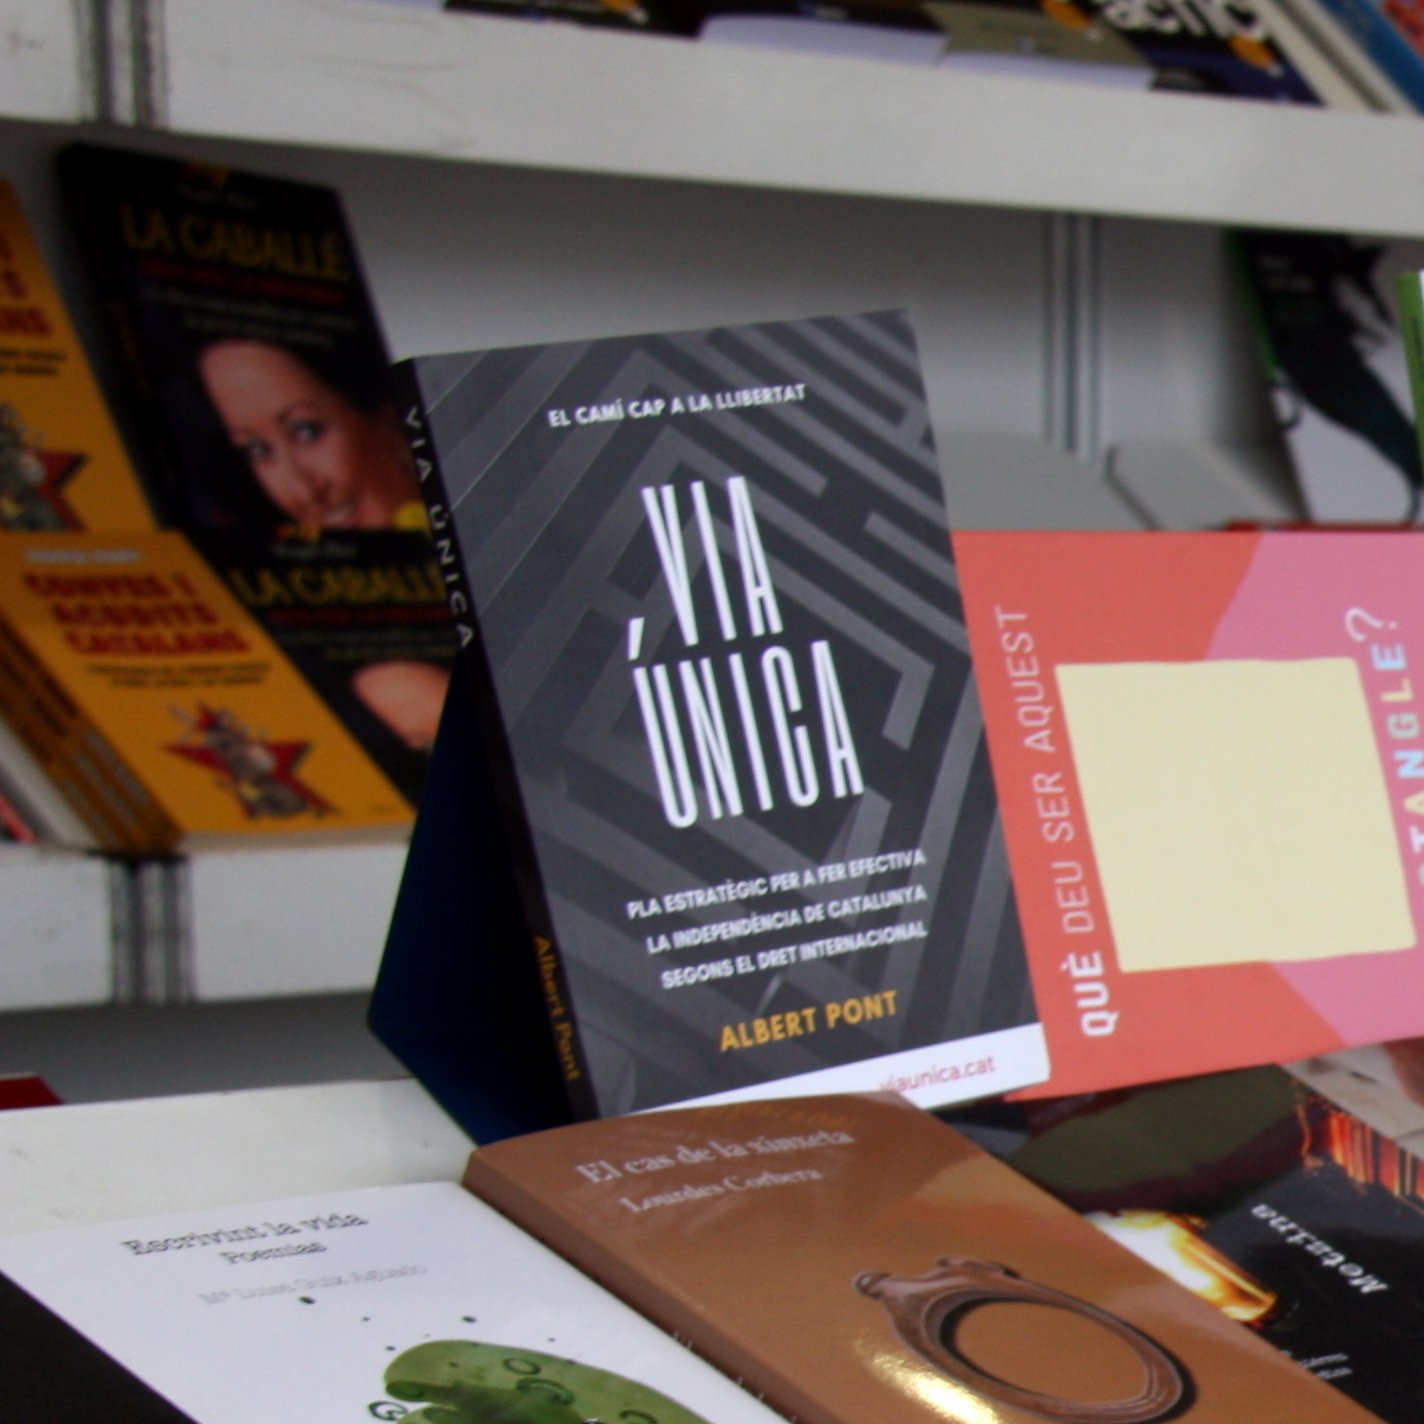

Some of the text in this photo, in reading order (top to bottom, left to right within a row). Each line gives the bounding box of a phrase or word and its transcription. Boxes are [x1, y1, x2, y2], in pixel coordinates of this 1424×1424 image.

[548, 384, 806, 427] EL CAMÍ CAP A LA LLIBERTAT
[404, 406, 433, 480] VIA
[641, 475, 783, 647] VIA
[627, 616, 865, 829] ÚNICA
[996, 606, 1119, 1037] QUÈ DEU SER AQUEST
[626, 848, 927, 920] PLA ESTRATÈGIC PER A FER EFECTIVA
[646, 884, 928, 954] LA INDEPENDÈNCIA DE CATALUNYA
[661, 920, 929, 989] SEGONS EL DRET INTERNACIONAL
[534, 935, 582, 1081] Albert Pont
[719, 990, 898, 1051] ALBERT PONT
[576, 1140, 749, 1183] El cas de la
[620, 1169, 824, 1213] Lourdes Corbera
[121, 1213, 369, 1256] Escrivint la vida
